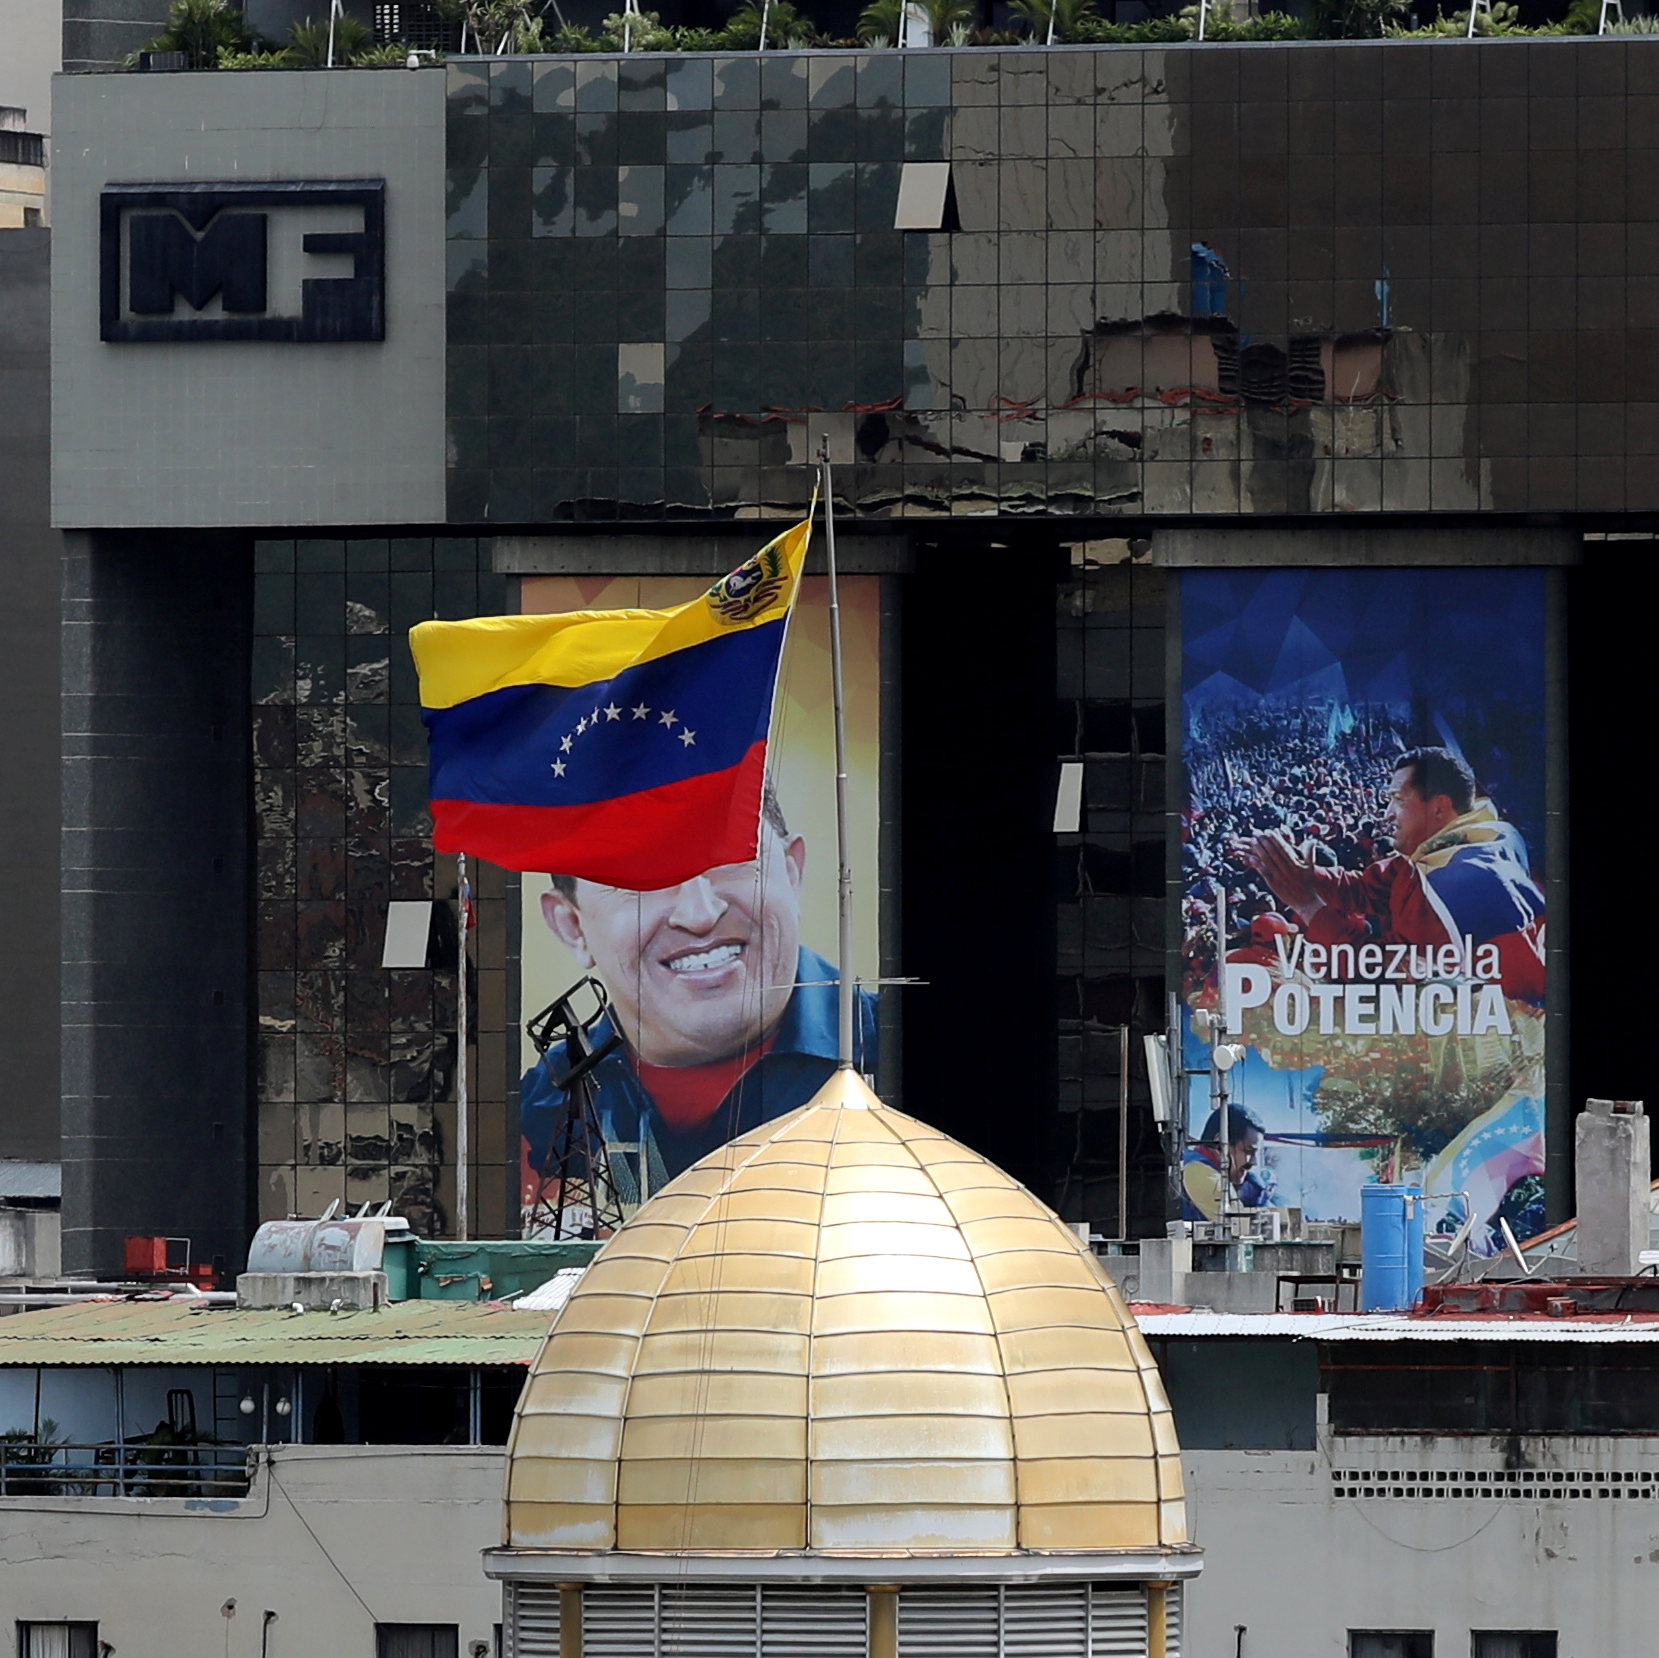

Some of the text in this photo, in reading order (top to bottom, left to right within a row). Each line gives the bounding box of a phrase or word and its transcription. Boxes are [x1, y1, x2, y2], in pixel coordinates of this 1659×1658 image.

[126, 204, 366, 320] MF
[1273, 933, 1502, 980] Venezuela
[1225, 962, 1513, 1037] POTENCIA
